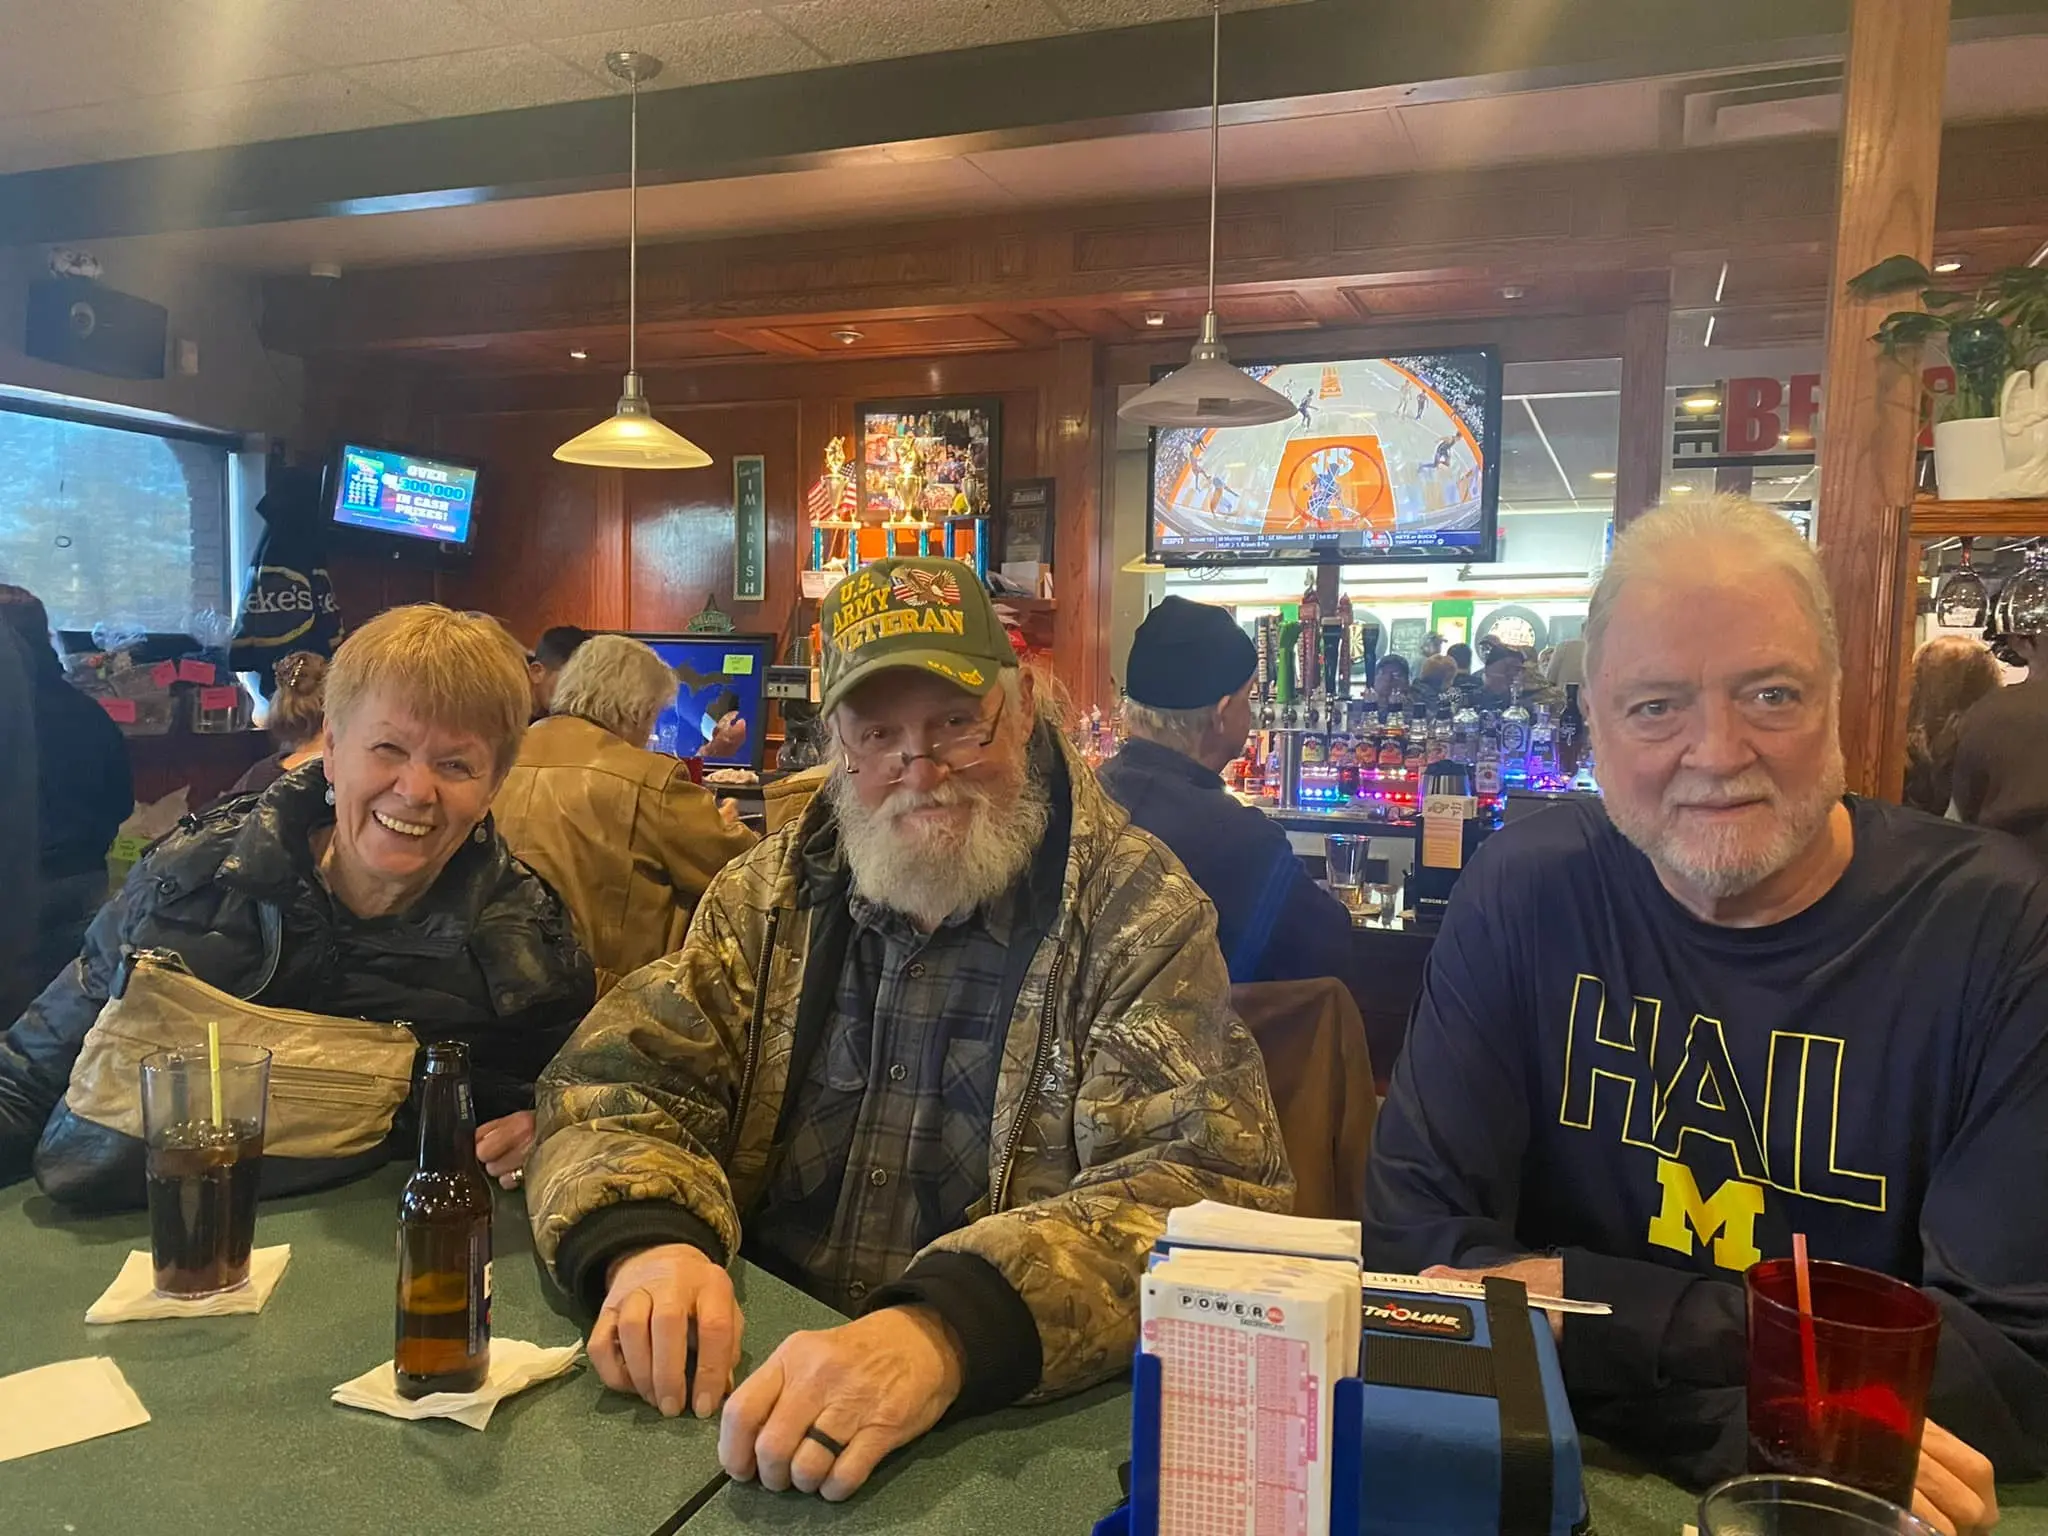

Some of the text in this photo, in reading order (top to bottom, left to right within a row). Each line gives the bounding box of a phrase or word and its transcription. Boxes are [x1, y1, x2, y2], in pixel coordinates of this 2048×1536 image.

[407, 465, 448, 482] OVER
[396, 493, 449, 511] IN CASH
[1162, 537, 1184, 545] ESPN
[244, 584, 314, 614] eke's
[839, 572, 875, 604] U.S.
[832, 585, 892, 634] ARMY
[832, 607, 965, 654] VETERAN
[1258, 625, 1268, 683] BUD LIGHT
[1559, 972, 1887, 1213] HAIL
[1648, 1156, 1765, 1272] M
[1361, 1304, 1461, 1327] TROLINE
